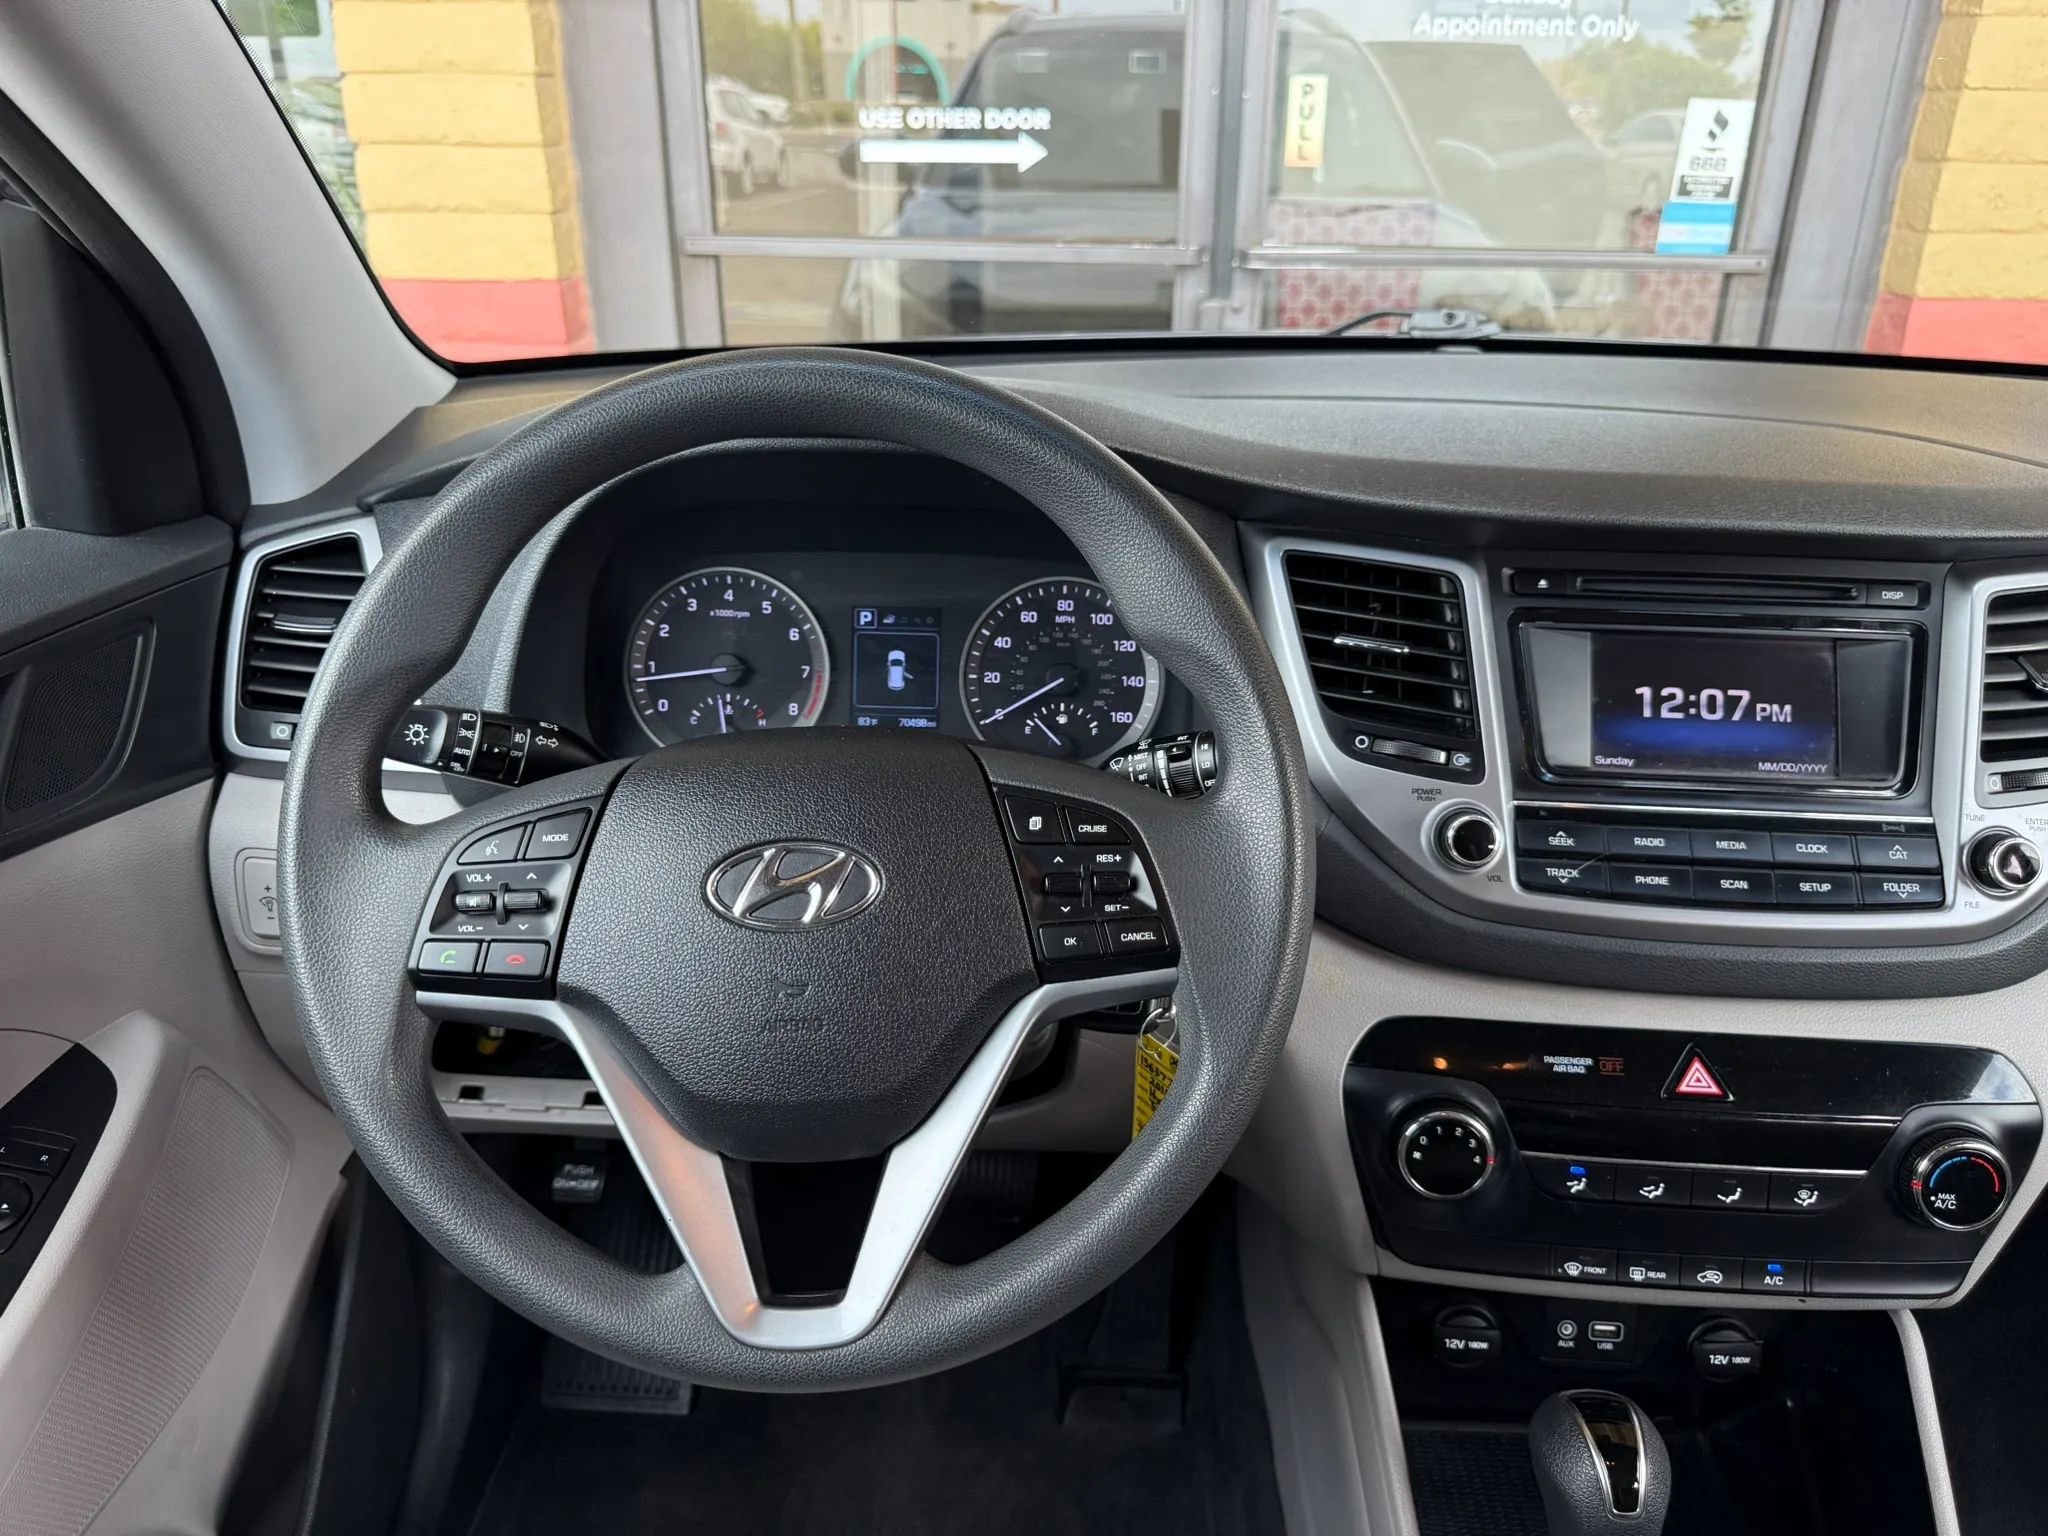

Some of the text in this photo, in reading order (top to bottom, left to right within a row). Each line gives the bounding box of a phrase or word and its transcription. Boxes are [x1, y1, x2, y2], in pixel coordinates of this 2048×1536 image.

[1412, 12, 1640, 42] Appointment Only
[858, 106, 1051, 130] USE OTHER DOOR
[1298, 82, 1314, 161] PULL
[724, 589, 734, 601] 4
[1881, 590, 1904, 601] DISP
[687, 599, 697, 612] 3
[761, 601, 772, 614] 5
[1057, 600, 1074, 611] 80
[860, 611, 873, 626] P
[1020, 611, 1037, 623] 60
[1055, 615, 1075, 624] MPH
[1090, 613, 1113, 625] 100
[659, 624, 670, 637] 2
[788, 628, 800, 641] 6
[993, 637, 1012, 648] 40
[1113, 640, 1136, 652] 120
[648, 661, 656, 673] 1
[801, 665, 810, 678] 7
[983, 672, 1000, 683] 20
[1121, 675, 1144, 687] 140
[657, 698, 669, 712] 0
[788, 703, 799, 716] 8
[1635, 686, 1792, 723] 12:07 PM
[1110, 711, 1133, 723] 160
[1025, 726, 1031, 734] E
[1092, 728, 1098, 736] F
[454, 747, 471, 756] AUTO
[1594, 755, 1635, 768] Sunday
[1757, 761, 1828, 774] MM/DD/YYYY
[1411, 788, 1442, 796] POWER
[1965, 813, 1985, 822] TUNE
[1078, 825, 1107, 833] CRUISE
[542, 833, 569, 843] MODE
[1548, 836, 1574, 847] SEEK
[1634, 837, 1665, 847] RADIO
[1716, 840, 1747, 850] MEDIA
[1796, 843, 1828, 854] CLOCK
[1889, 850, 1907, 860] CAT
[1545, 867, 1580, 878] TRACK
[1487, 874, 1503, 883] VOL
[1635, 875, 1669, 885] PHONE
[1720, 879, 1748, 890] SCAN
[1799, 882, 1831, 892] SETUP
[1883, 882, 1920, 894] FOLDER
[1965, 901, 1980, 909] FILE
[1064, 937, 1077, 946] OK
[1120, 931, 1156, 942] CANCEL
[1543, 1055, 1593, 1066] PASSENGER
[1600, 1060, 1624, 1072] OFF
[1436, 1126, 1442, 1135] 1
[1455, 1127, 1463, 1136] 2
[1419, 1136, 1427, 1145] 0
[1468, 1138, 1476, 1148] 3
[1473, 1155, 1480, 1164] 4
[1935, 1200, 1957, 1210] A/C
[1584, 1267, 1607, 1275] FRONT
[1647, 1271, 1666, 1279] REAR
[1764, 1276, 1783, 1285] A/C
[1444, 1338, 1465, 1350] 12V
[1557, 1339, 1574, 1348] AUX
[1597, 1342, 1613, 1350] USB
[1709, 1354, 1729, 1365] 12V
